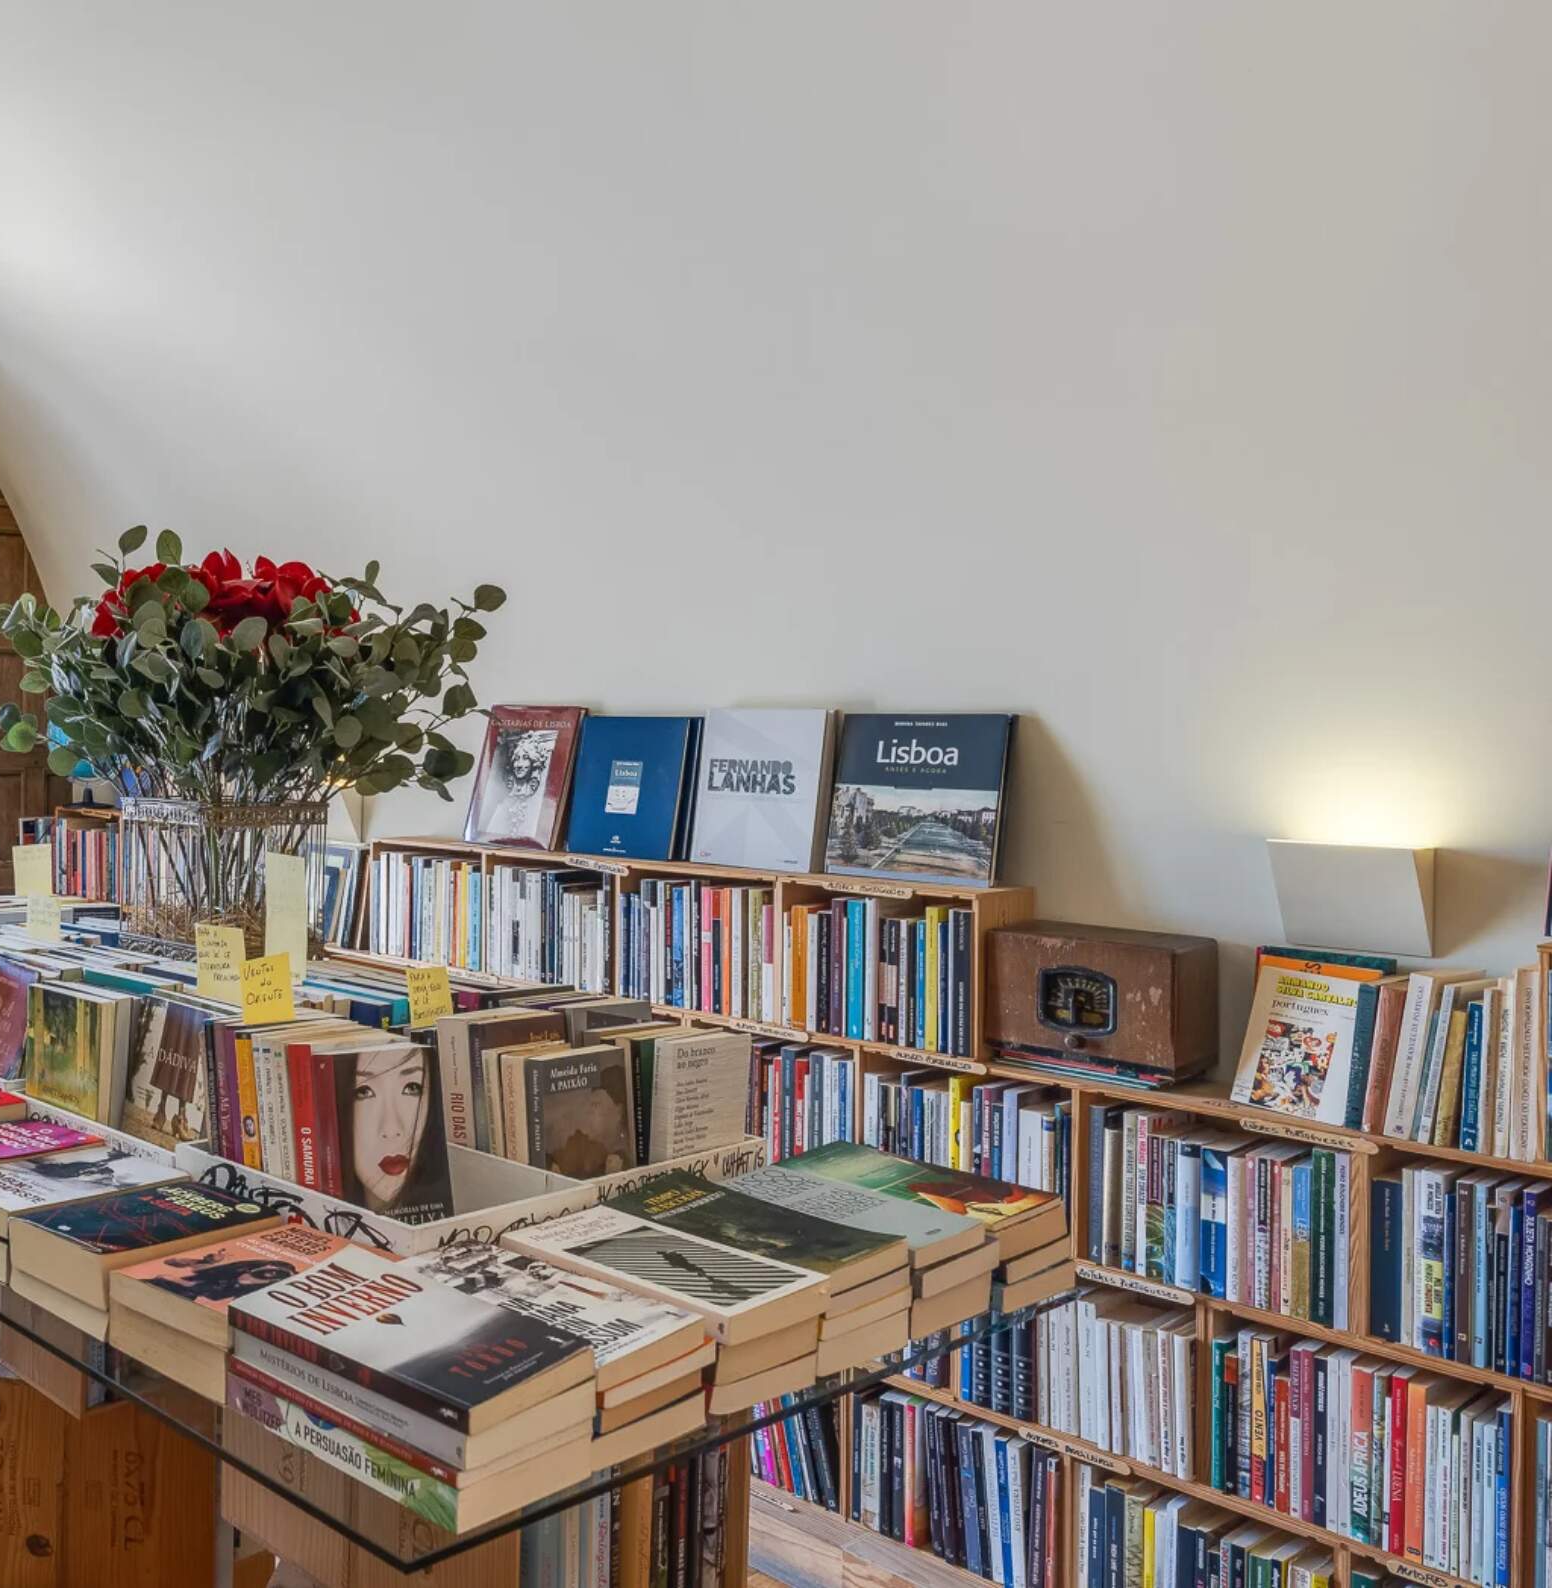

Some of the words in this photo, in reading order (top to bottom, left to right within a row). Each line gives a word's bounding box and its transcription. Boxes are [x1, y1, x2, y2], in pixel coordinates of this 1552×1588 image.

[876, 739, 960, 766] Lisboa
[709, 758, 793, 776] FERNANDO
[707, 772, 797, 796] LANHAS
[1276, 984, 1305, 997] SILVA
[1277, 975, 1330, 992] ARMANDO
[157, 1047, 198, 1074] DÁDIVA
[677, 1046, 689, 1057] Do
[690, 1046, 716, 1057] branco
[550, 1065, 578, 1079] Almeida
[579, 1062, 598, 1075] Faria
[677, 1061, 687, 1070] ao
[689, 1059, 709, 1070] negro
[550, 1080, 556, 1092] A
[558, 1076, 588, 1091] PAIXÃO
[450, 1092, 465, 1113] RIO
[301, 1127, 311, 1136] O
[451, 1114, 466, 1139] DAS
[1138, 1117, 1147, 1139] MIGUEL
[301, 1137, 315, 1185] SAMURAI
[1138, 1140, 1147, 1165] MIRANDA
[1338, 1164, 1346, 1180] PEDRO
[385, 1204, 418, 1216] MEMÓRIAS
[419, 1203, 427, 1211] DE
[428, 1202, 444, 1210] UMA
[1524, 1215, 1535, 1245] JULIETA
[267, 1288, 298, 1309] O
[296, 1262, 371, 1299] BOM
[286, 1273, 424, 1336] INVERNO
[259, 1348, 308, 1384] MISTÉRIOS
[308, 1374, 321, 1390] DE
[322, 1378, 356, 1405] LISBOA
[239, 1399, 283, 1433] WOLITZER
[1254, 1409, 1264, 1442] VENTO
[294, 1421, 302, 1438] A
[303, 1423, 363, 1473] PERSUASÃO
[363, 1457, 417, 1499] FEMININA
[1351, 1470, 1369, 1518] ADEUS
[124, 1516, 145, 1552] CL
